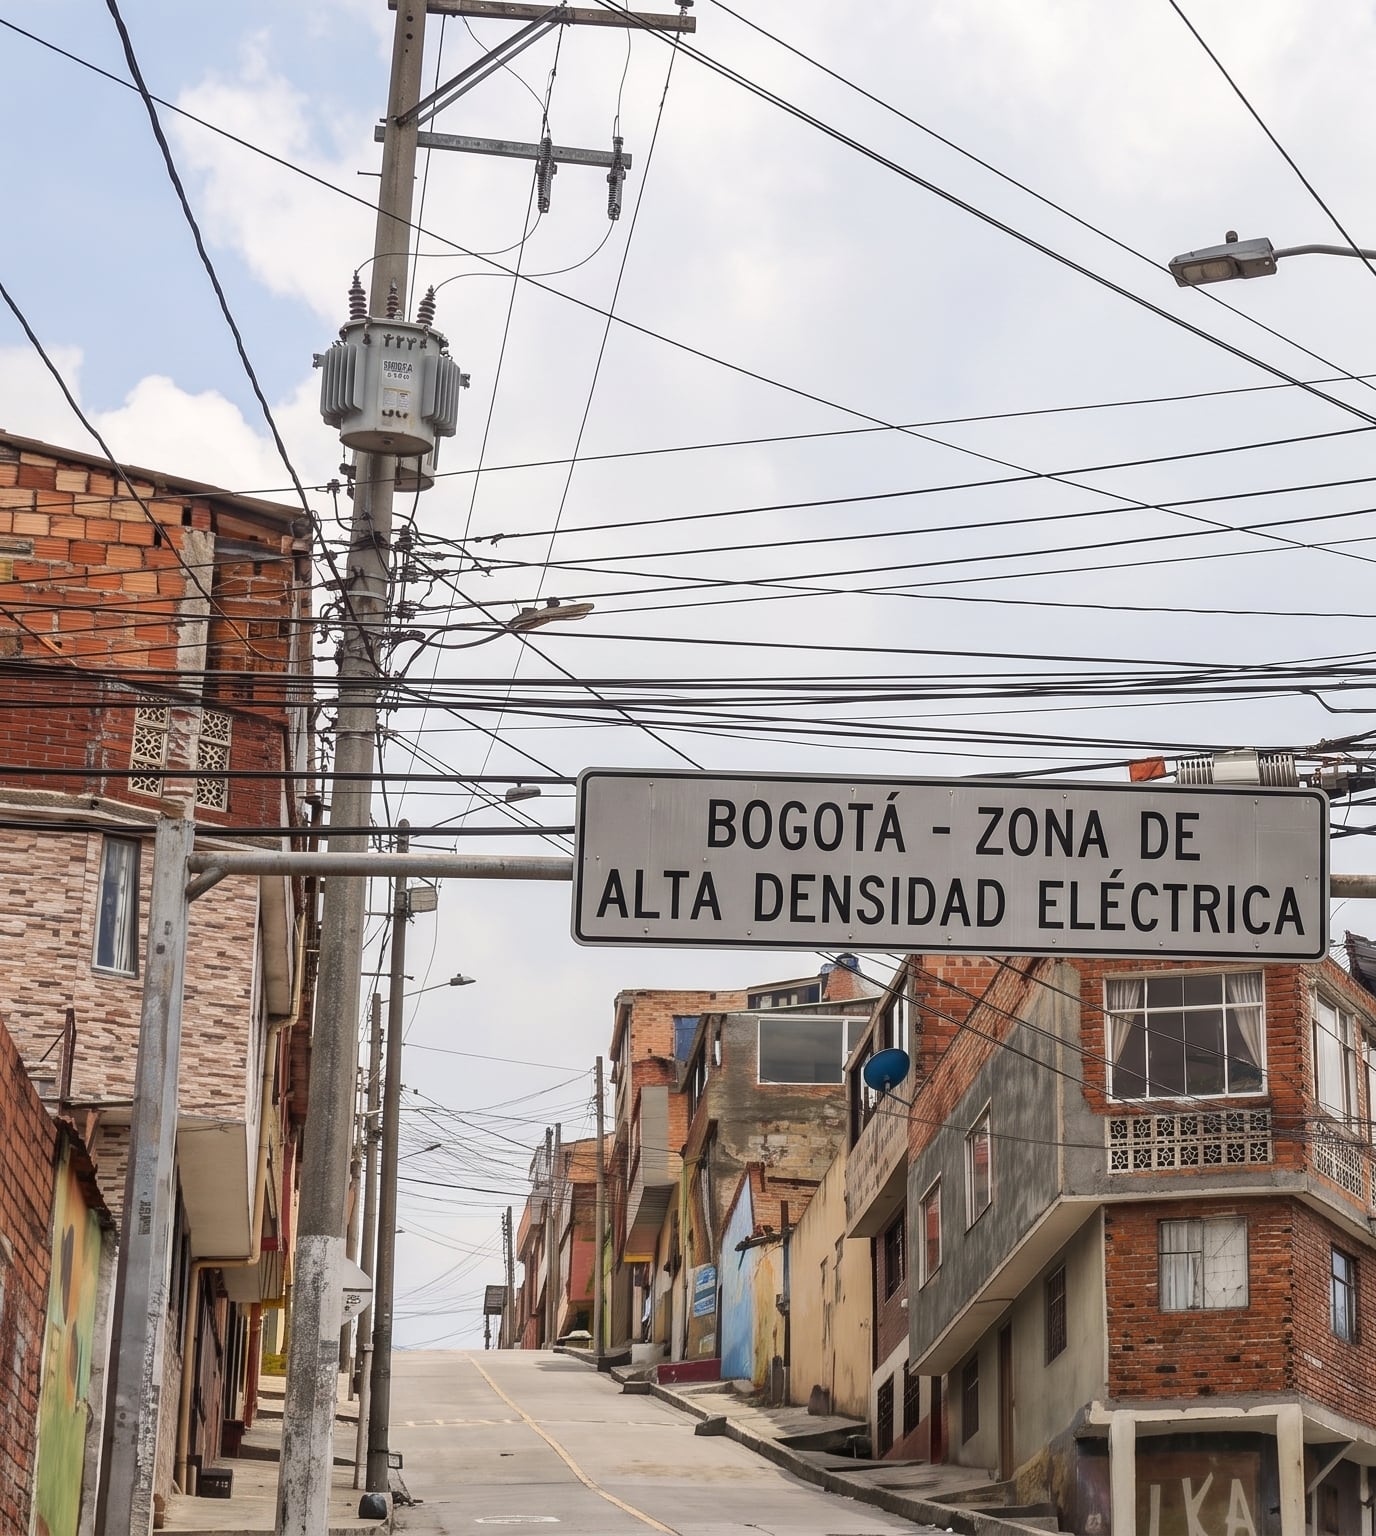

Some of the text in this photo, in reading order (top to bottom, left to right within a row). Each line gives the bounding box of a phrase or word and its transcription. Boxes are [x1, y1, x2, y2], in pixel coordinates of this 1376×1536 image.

[707, 791, 906, 853] BOGOTÁ
[975, 806, 1110, 859] ZONA
[1140, 810, 1201, 862] DE
[596, 868, 1305, 936] ALTA DENSIDAD ELÉCTRICA
